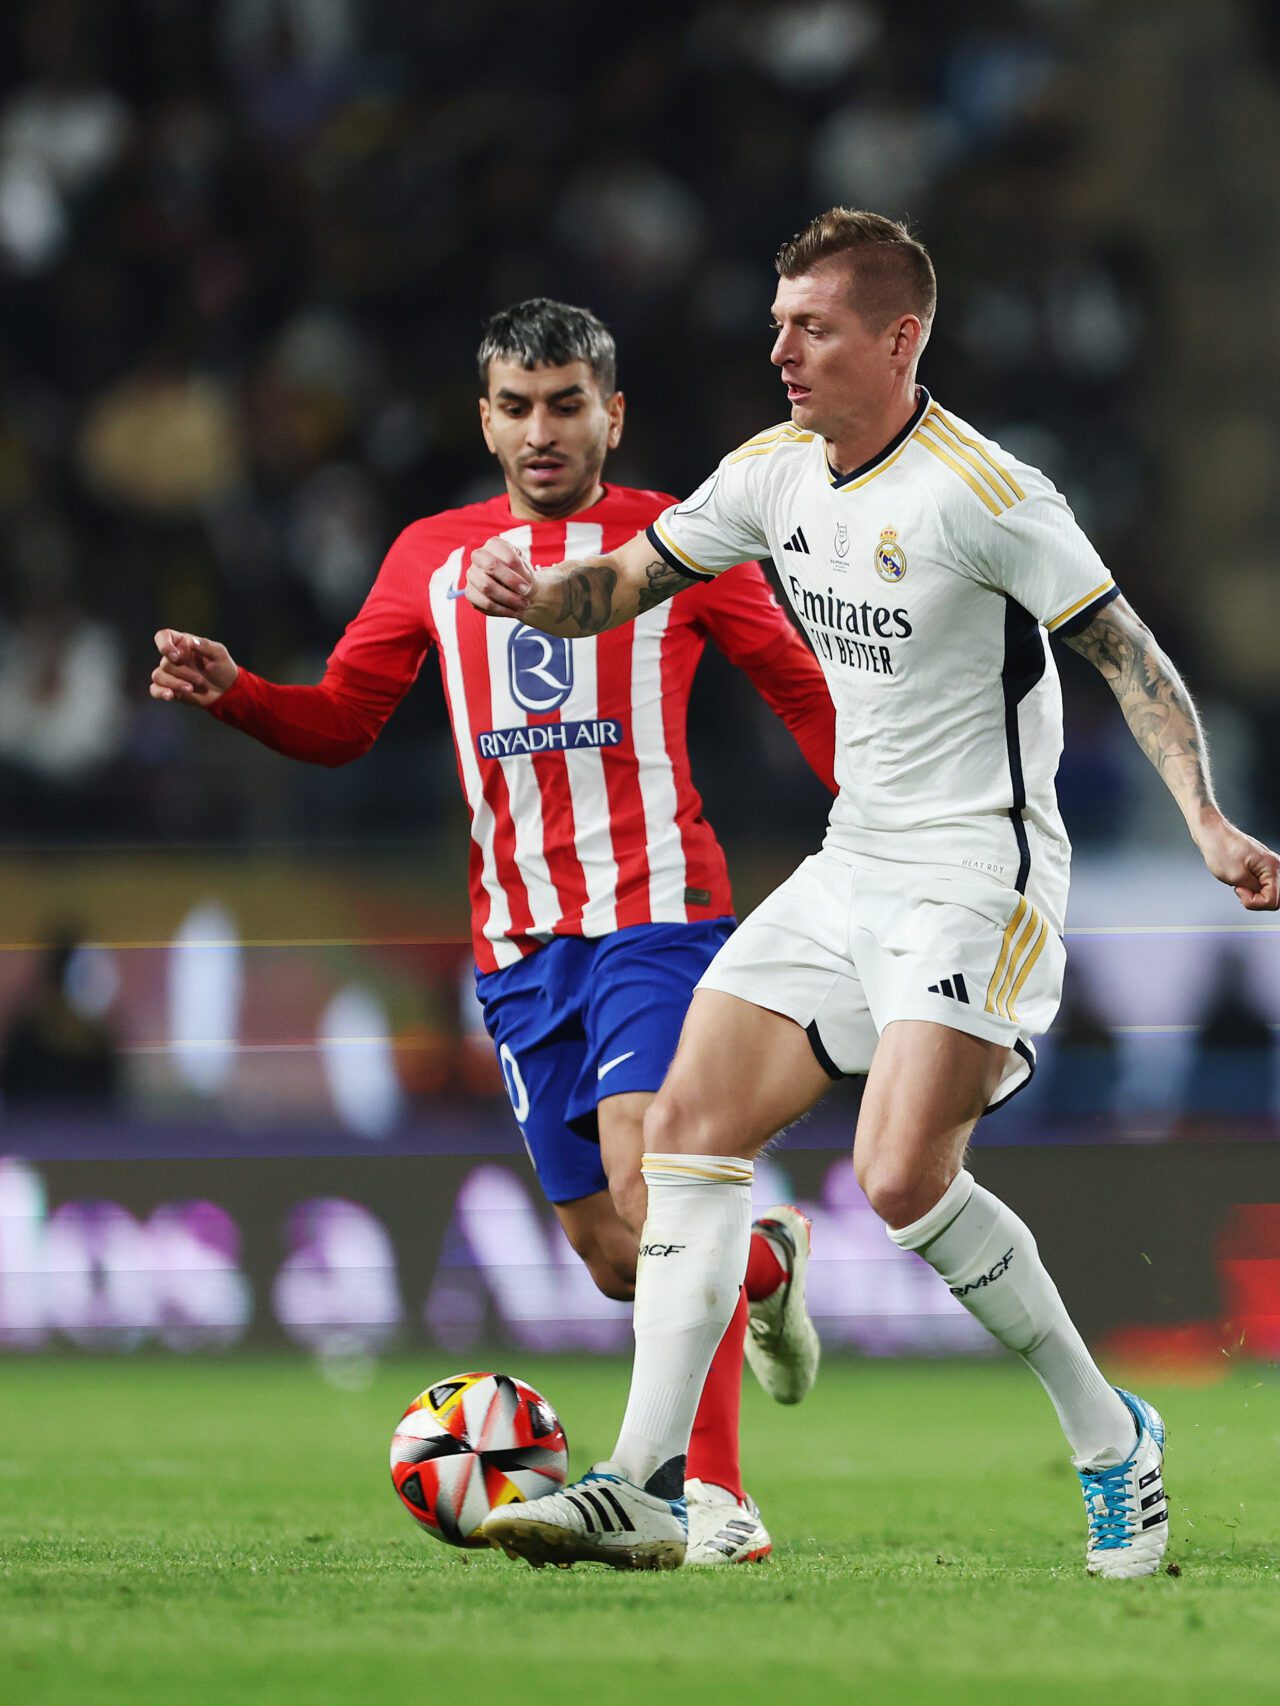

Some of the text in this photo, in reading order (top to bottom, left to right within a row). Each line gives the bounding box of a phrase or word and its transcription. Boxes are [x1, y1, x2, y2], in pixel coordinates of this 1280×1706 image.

[788, 575, 912, 639] Emirates
[835, 635, 894, 675] BETTER
[479, 721, 619, 757] RIYADH AIR
[500, 1043, 530, 1124] 0
[638, 1244, 686, 1257] MCF
[949, 1247, 1014, 1297] RMCF
